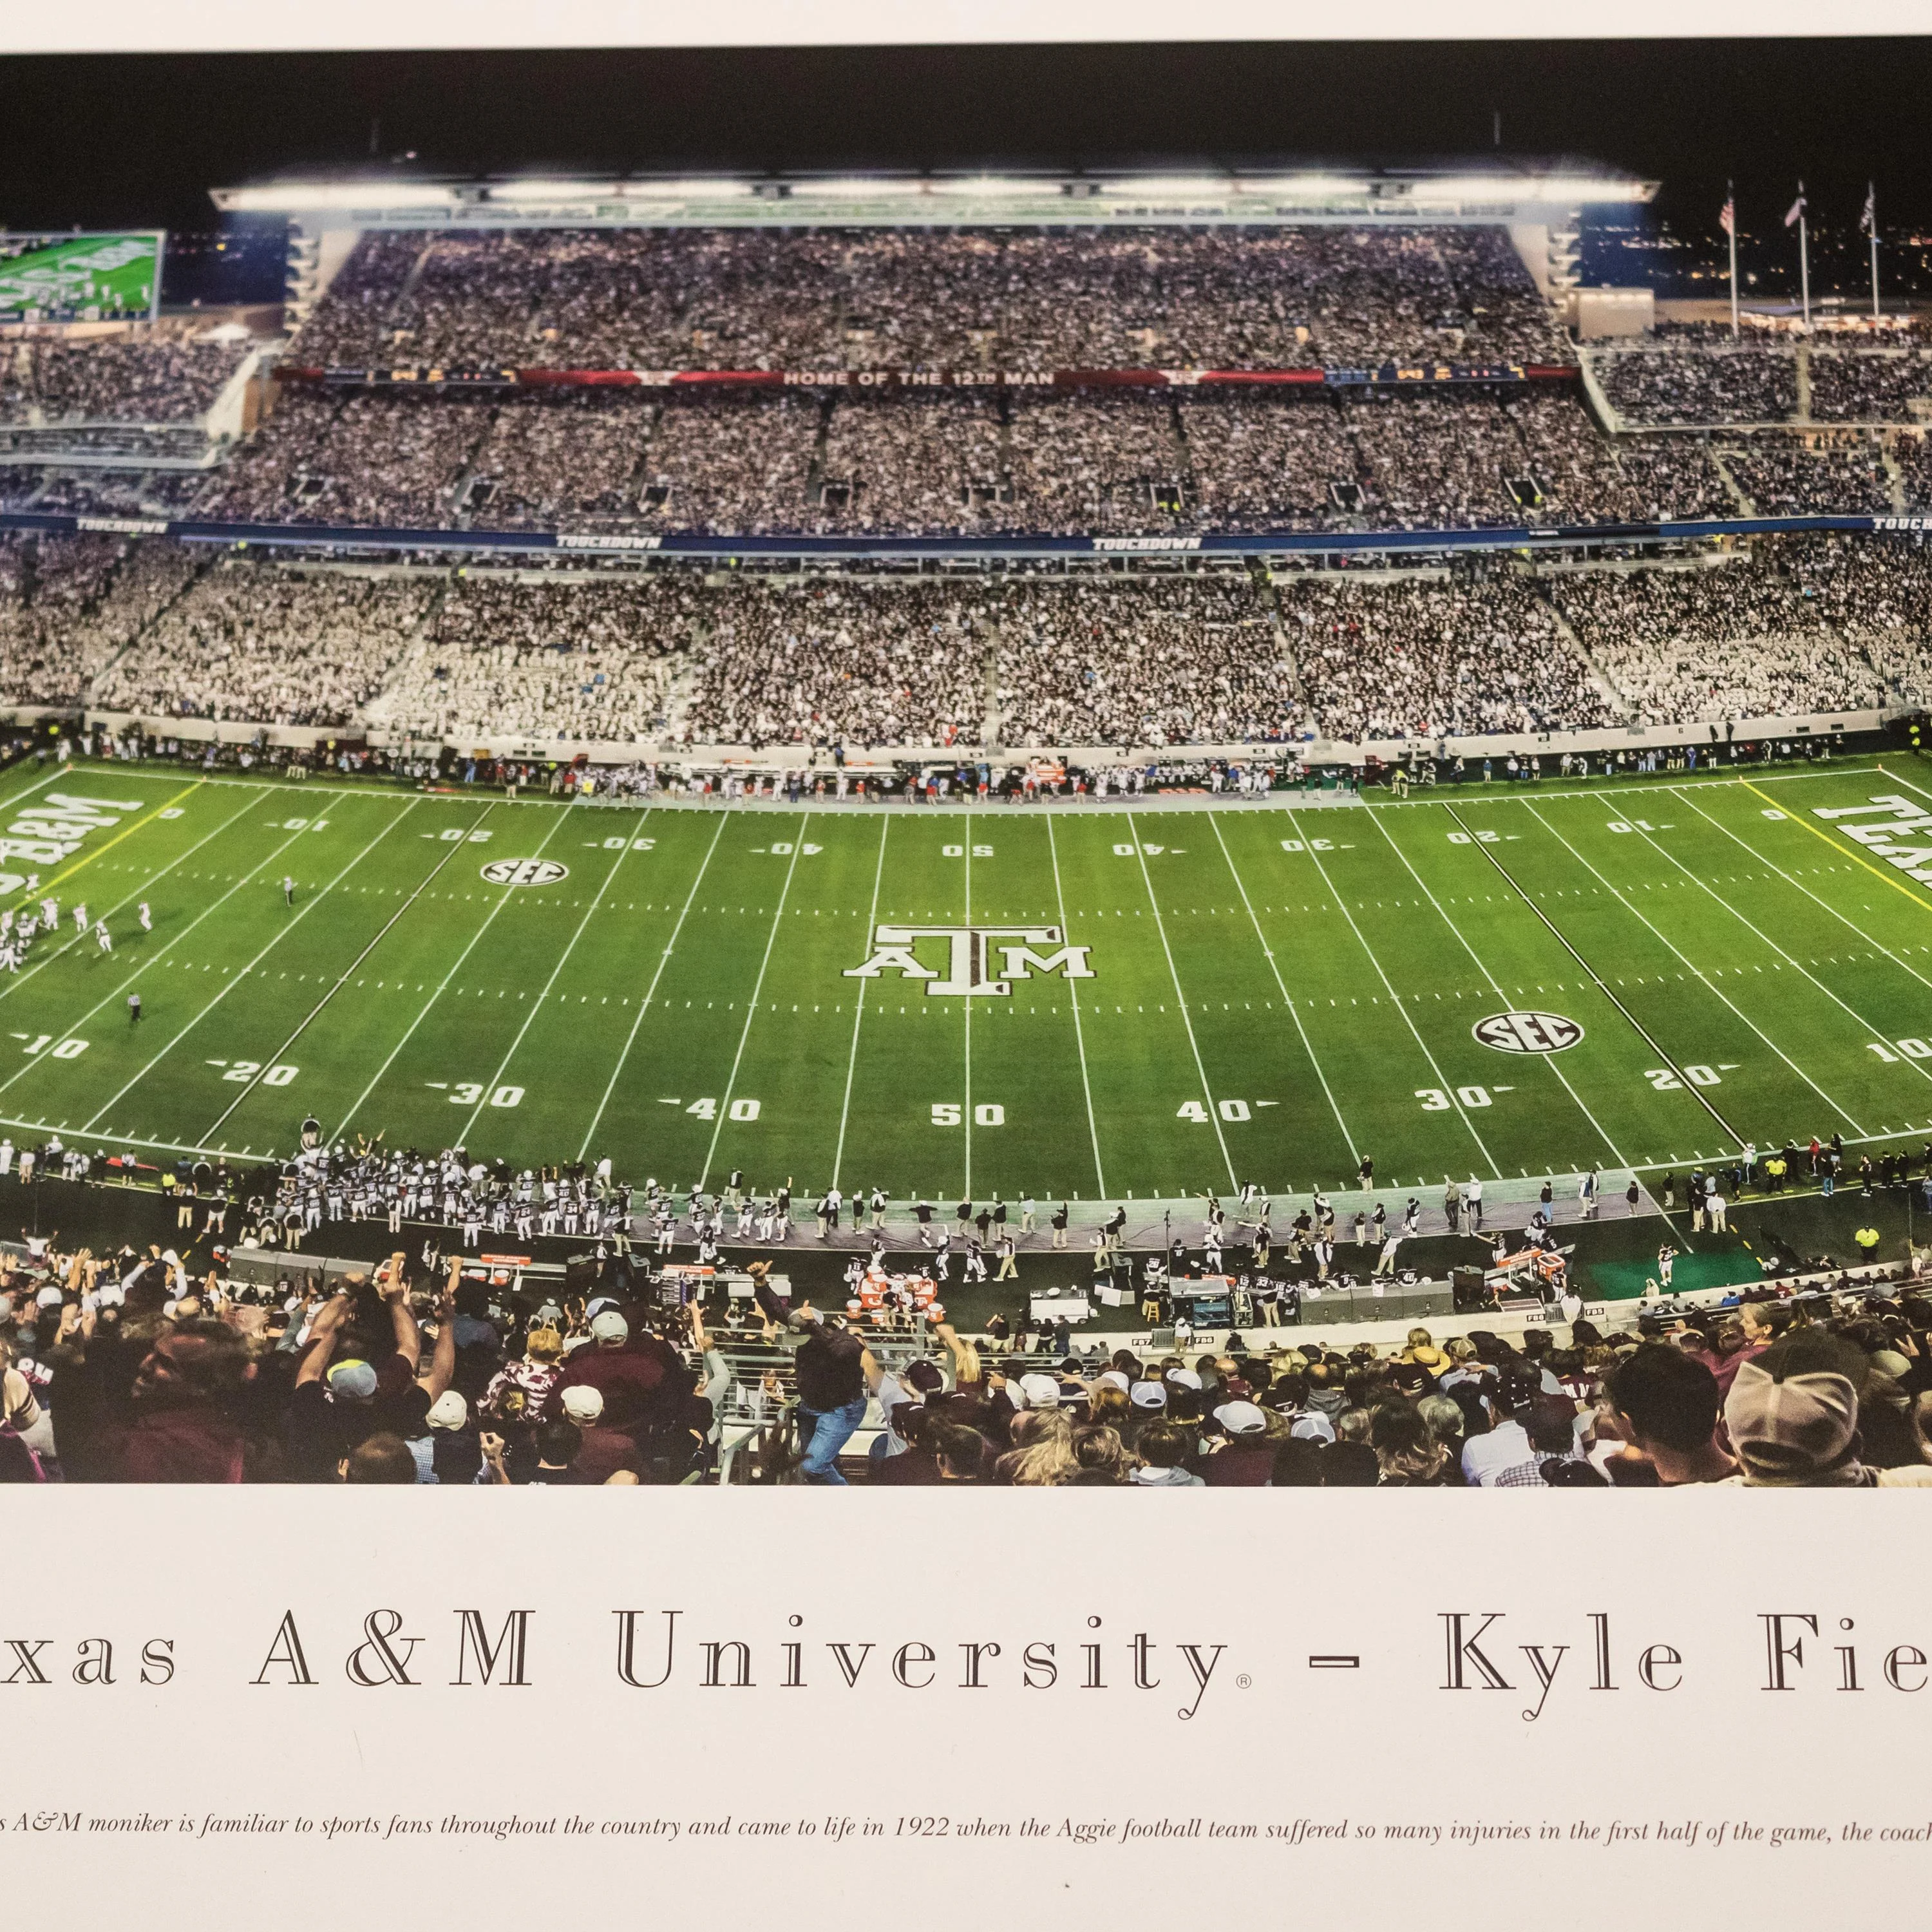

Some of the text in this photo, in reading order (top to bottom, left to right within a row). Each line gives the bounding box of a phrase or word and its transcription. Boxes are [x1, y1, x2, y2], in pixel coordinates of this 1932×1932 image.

[783, 372, 849, 385] HOME
[858, 372, 889, 385] OF
[898, 372, 942, 385] THE
[1004, 372, 1055, 384] MAN
[556, 535, 662, 549] TOUCHDOWN
[1092, 538, 1202, 550] TOUCHDOWN
[487, 862, 566, 885] SEC
[1480, 1012, 1577, 1051] SEC
[24, 1036, 90, 1059] 10
[223, 1061, 299, 1086] 20
[1643, 1065, 1722, 1090] 20
[449, 1083, 525, 1108] 30
[1414, 1085, 1493, 1112] 30
[686, 1097, 761, 1121] 40
[931, 1104, 1005, 1126] 50
[1176, 1099, 1251, 1122] 40
[0, 1639, 175, 1685] xas
[249, 1609, 535, 1686] A&M
[1437, 1613, 1681, 1721] Kyle
[1757, 1615, 1928, 1692] Fie
[12, 1812, 82, 1831] A&M
[89, 1814, 173, 1832] moniker
[179, 1814, 194, 1832] is
[196, 1814, 289, 1839] familiar
[295, 1817, 313, 1832] to
[320, 1815, 380, 1839] sports
[383, 1815, 433, 1839] fans
[441, 1815, 556, 1840] throughout
[564, 1815, 594, 1834] the
[601, 1819, 681, 1842] country
[688, 1817, 731, 1835] and
[738, 1823, 791, 1835] came
[798, 1820, 816, 1835] to
[824, 1817, 856, 1842] life
[863, 1817, 883, 1835] in
[896, 1817, 949, 1836] 1922
[957, 1818, 1010, 1836] when
[1020, 1818, 1050, 1836] the
[1057, 1819, 1116, 1842] Aggie
[1119, 1819, 1202, 1843] football
[1209, 1822, 1258, 1837] team
[1266, 1820, 1348, 1844] suffered
[1355, 1826, 1376, 1838] so
[1385, 1826, 1441, 1846] many
[1451, 1821, 1531, 1845] injuries
[1540, 1821, 1560, 1839] in
[1570, 1821, 1600, 1839] the
[1604, 1821, 1647, 1846] first
[1657, 1821, 1702, 1846] half
[1707, 1822, 1729, 1846] of
[1734, 1822, 1763, 1841] the
[1770, 1828, 1831, 1846] game,
[1842, 1822, 1873, 1841] the
